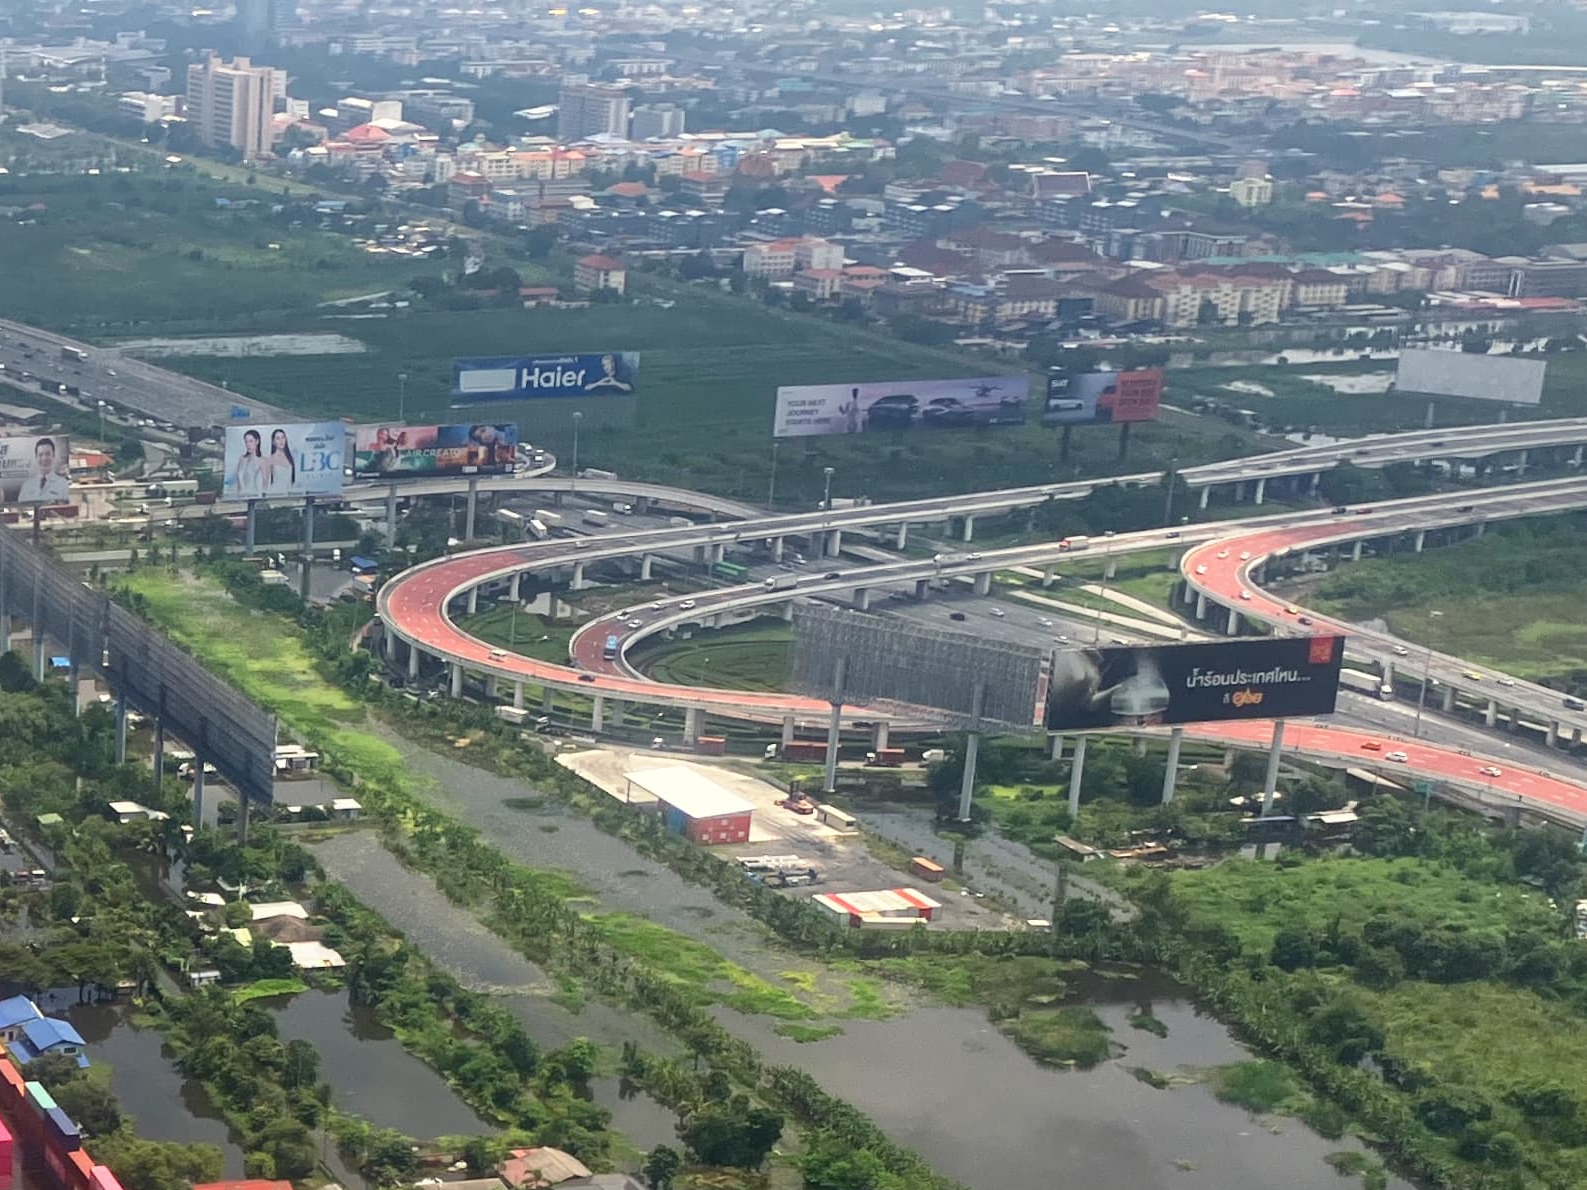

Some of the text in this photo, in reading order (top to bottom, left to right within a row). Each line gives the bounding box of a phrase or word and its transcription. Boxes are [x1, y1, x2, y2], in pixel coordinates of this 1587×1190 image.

[521, 365, 586, 389] Haier
[788, 398, 828, 407] YOUR NEXT
